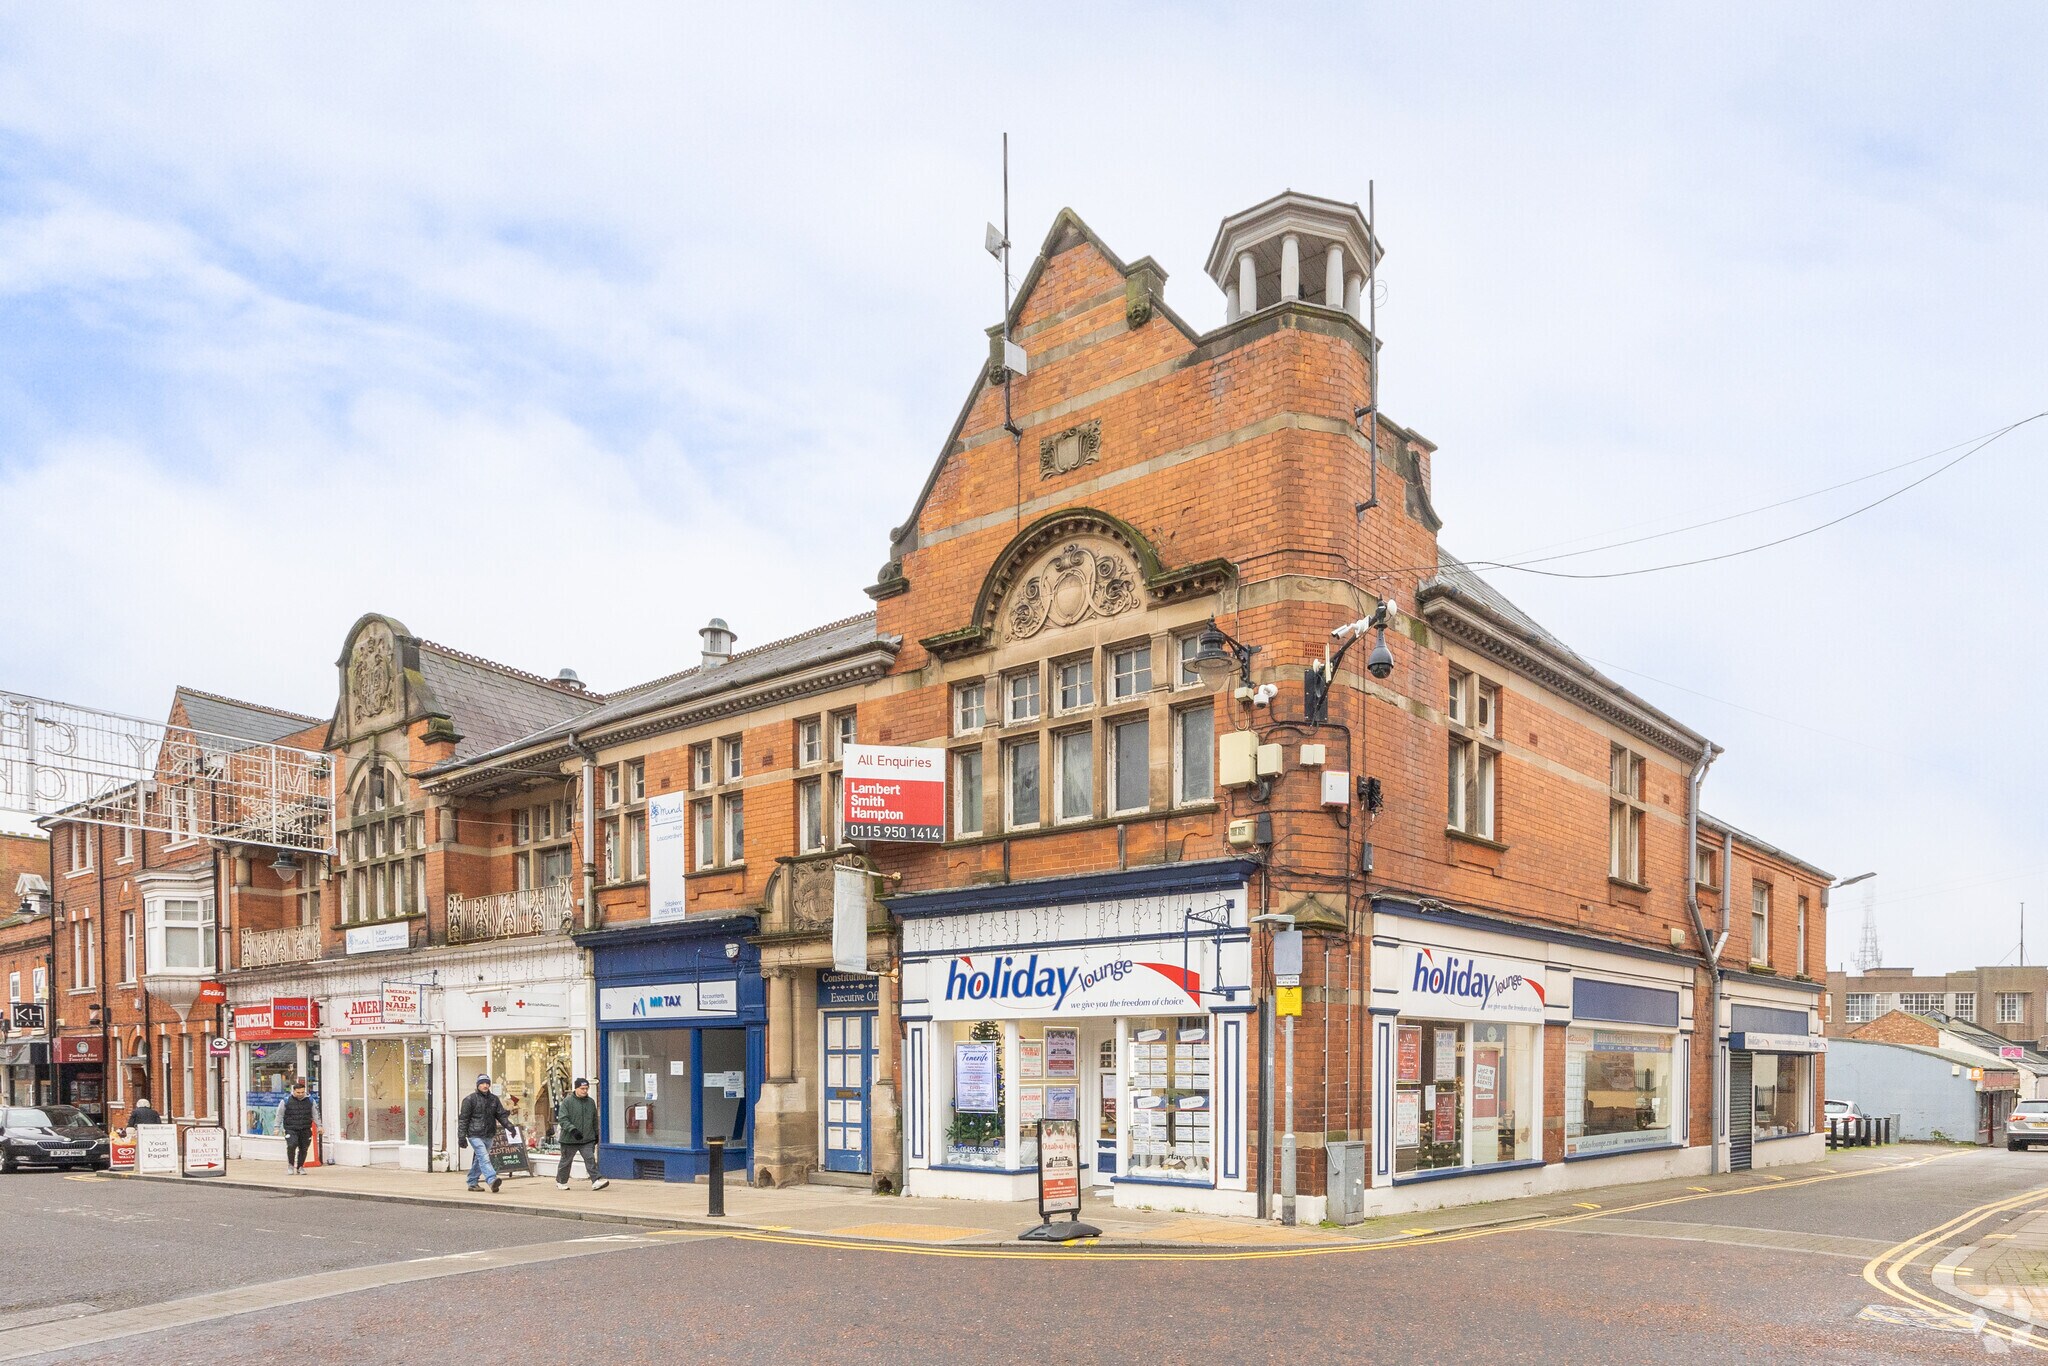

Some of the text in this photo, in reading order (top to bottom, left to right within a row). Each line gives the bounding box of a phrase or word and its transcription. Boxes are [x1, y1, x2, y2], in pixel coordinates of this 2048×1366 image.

[857, 754, 932, 769] All Enquiries
[850, 782, 901, 795] Lambert
[850, 795, 885, 807] Smith
[851, 807, 904, 822] Hampton
[850, 825, 940, 839] 0115 950 1414
[945, 954, 1133, 1011] holiday lounge
[1412, 952, 1522, 1011] holiday lounge
[649, 995, 682, 1008] MR TAX
[708, 998, 728, 1006] Specialists
[830, 991, 865, 1003] Executive
[385, 1002, 417, 1010] NAILS
[492, 1005, 507, 1013] British
[1081, 1000, 1095, 1011] give
[1096, 1001, 1109, 1010] you
[1109, 999, 1121, 1008] the
[1121, 998, 1151, 1007] freedom
[1151, 997, 1160, 1006] of
[1160, 996, 1184, 1006] choice
[15, 1008, 43, 1020] KH
[962, 1052, 988, 1062] Tenerife
[1052, 1093, 1071, 1103] Cyprus
